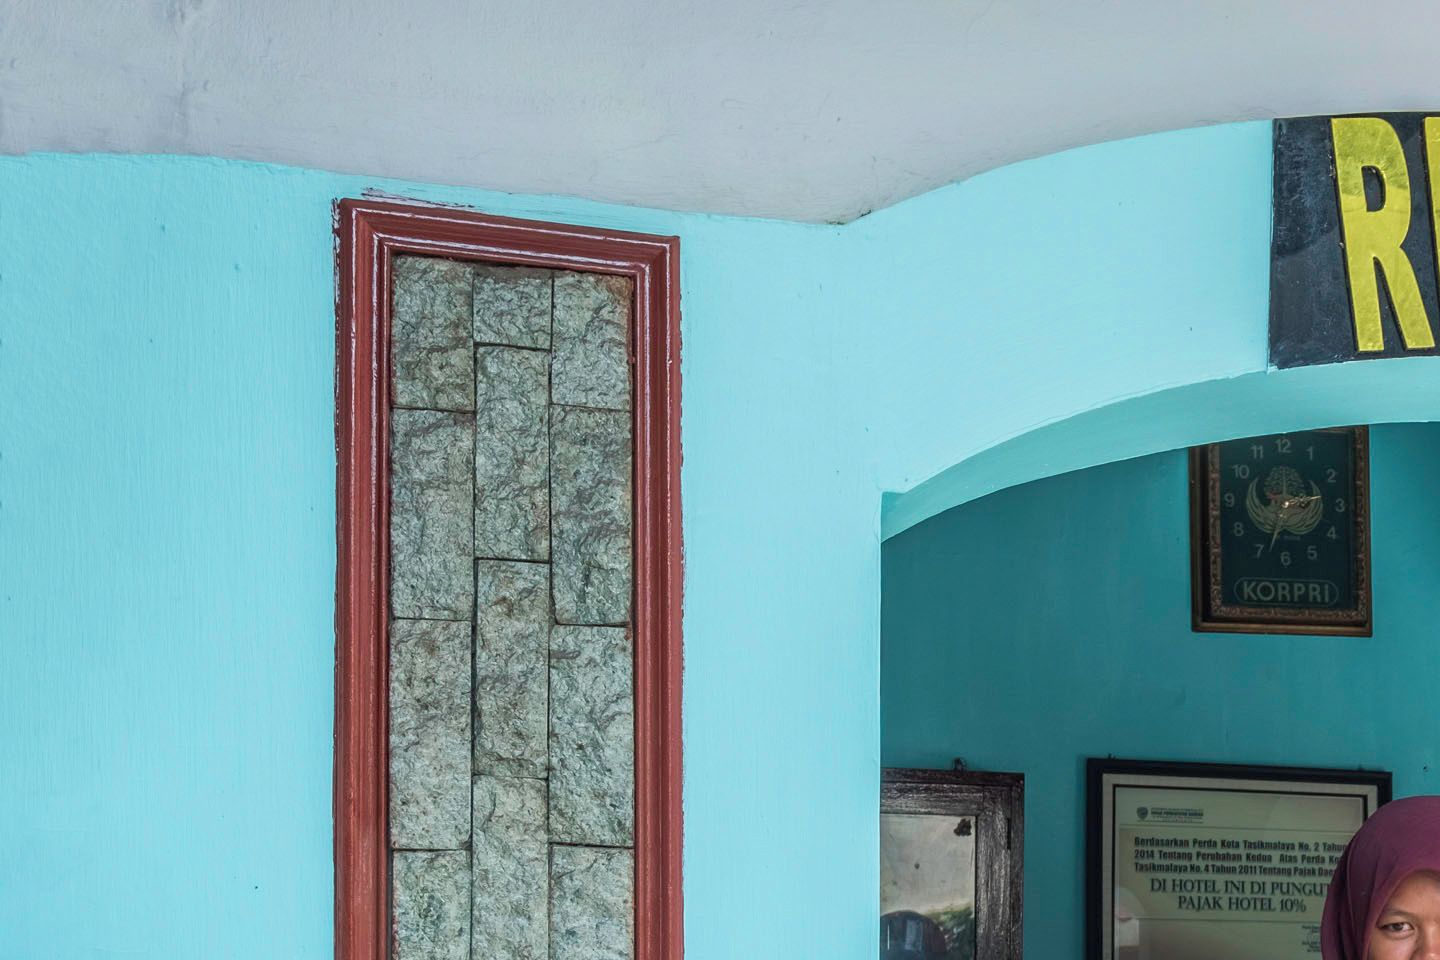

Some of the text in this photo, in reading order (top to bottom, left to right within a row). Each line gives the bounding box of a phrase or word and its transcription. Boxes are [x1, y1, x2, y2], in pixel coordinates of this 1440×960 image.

[1252, 445, 1264, 459] 11
[1275, 439, 1291, 453] 12
[1307, 446, 1313, 461] 1
[1232, 464, 1249, 479] 10
[1326, 469, 1336, 483] 2
[1224, 493, 1235, 507] 9
[1336, 499, 1345, 512] 3
[1234, 522, 1244, 536] 8
[1327, 526, 1337, 540] 4
[1254, 544, 1264, 558] 7
[1307, 546, 1318, 560] 5
[1280, 552, 1291, 566] 6
[1243, 581, 1329, 602] KORPRI
[1135, 837, 1189, 847] Berdasarkan
[1192, 839, 1217, 848] Perda
[1221, 839, 1240, 848] Kota
[1243, 840, 1295, 850] Tasikmalaya
[1298, 842, 1311, 851] No.
[1314, 842, 1320, 851] 2
[1134, 849, 1154, 859] 2014
[1158, 850, 1192, 861] Tentang
[1196, 851, 1242, 860] Perubahan
[1280, 853, 1298, 863] Atas
[1301, 854, 1325, 864] Perda
[1134, 862, 1188, 873] Tasikmalaya
[1190, 864, 1202, 873] No.
[1204, 864, 1209, 873] 4
[1211, 864, 1237, 873] Tahun
[1238, 865, 1256, 874] 2011
[1258, 866, 1292, 876] Tentang
[1293, 867, 1316, 876] Pajak
[1150, 878, 1166, 892] DI
[1172, 879, 1220, 893] HOTEL
[1224, 880, 1245, 894] INI
[1250, 881, 1266, 894] DI
[1178, 896, 1306, 912] PAJAK HOTEL 10%
